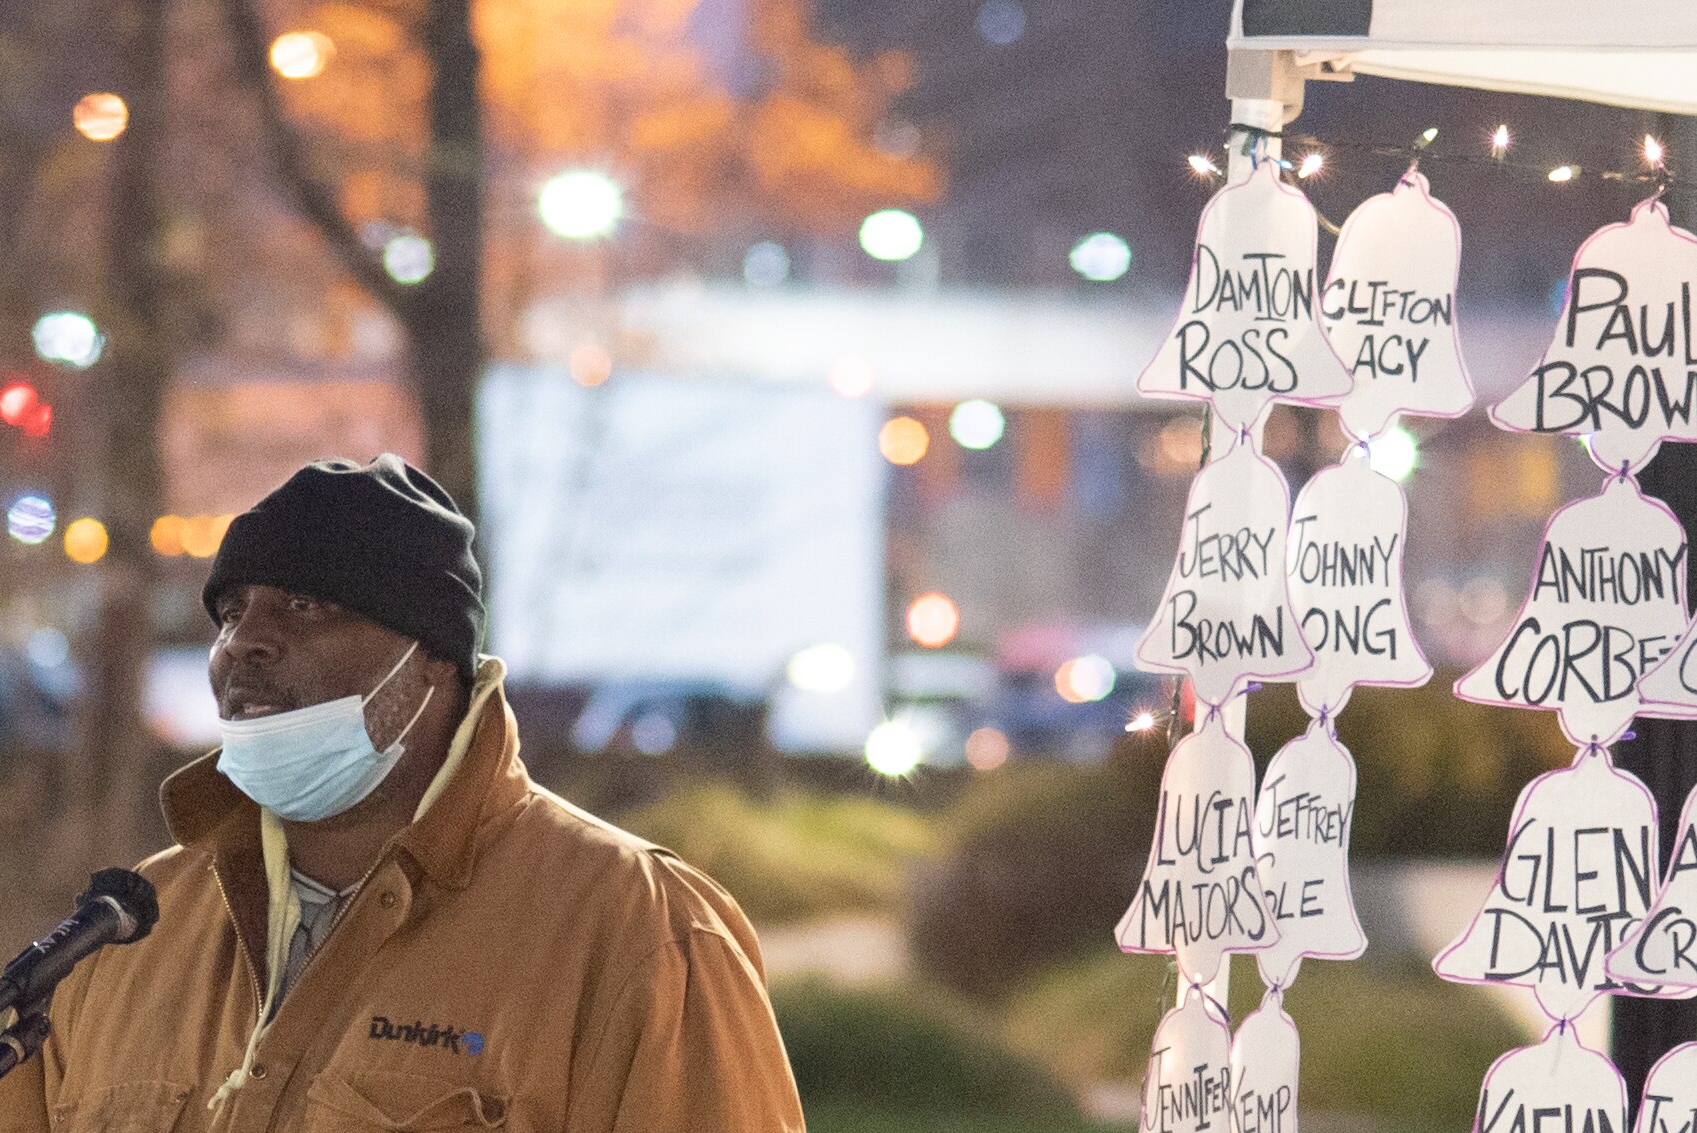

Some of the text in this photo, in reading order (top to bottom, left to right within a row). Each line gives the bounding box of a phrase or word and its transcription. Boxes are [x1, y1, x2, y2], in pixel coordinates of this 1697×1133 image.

[1192, 243, 1314, 323] DAMION
[1321, 277, 1452, 328] CLIFTON
[1174, 319, 1299, 393] ROSS
[1326, 326, 1431, 383] ACY
[1531, 360, 1697, 432] BROW
[1179, 502, 1276, 582] JERRY
[1288, 514, 1399, 587] JOHNNY
[1533, 543, 1687, 605] ANTHONY
[1169, 589, 1284, 667] BROWN
[1301, 598, 1397, 661] ONG
[1494, 616, 1682, 704] CORBE
[1157, 789, 1255, 874] LUCIA
[1259, 773, 1354, 848] JEFFREY
[1500, 817, 1653, 915] GLEN
[1141, 865, 1266, 949] MAJORS
